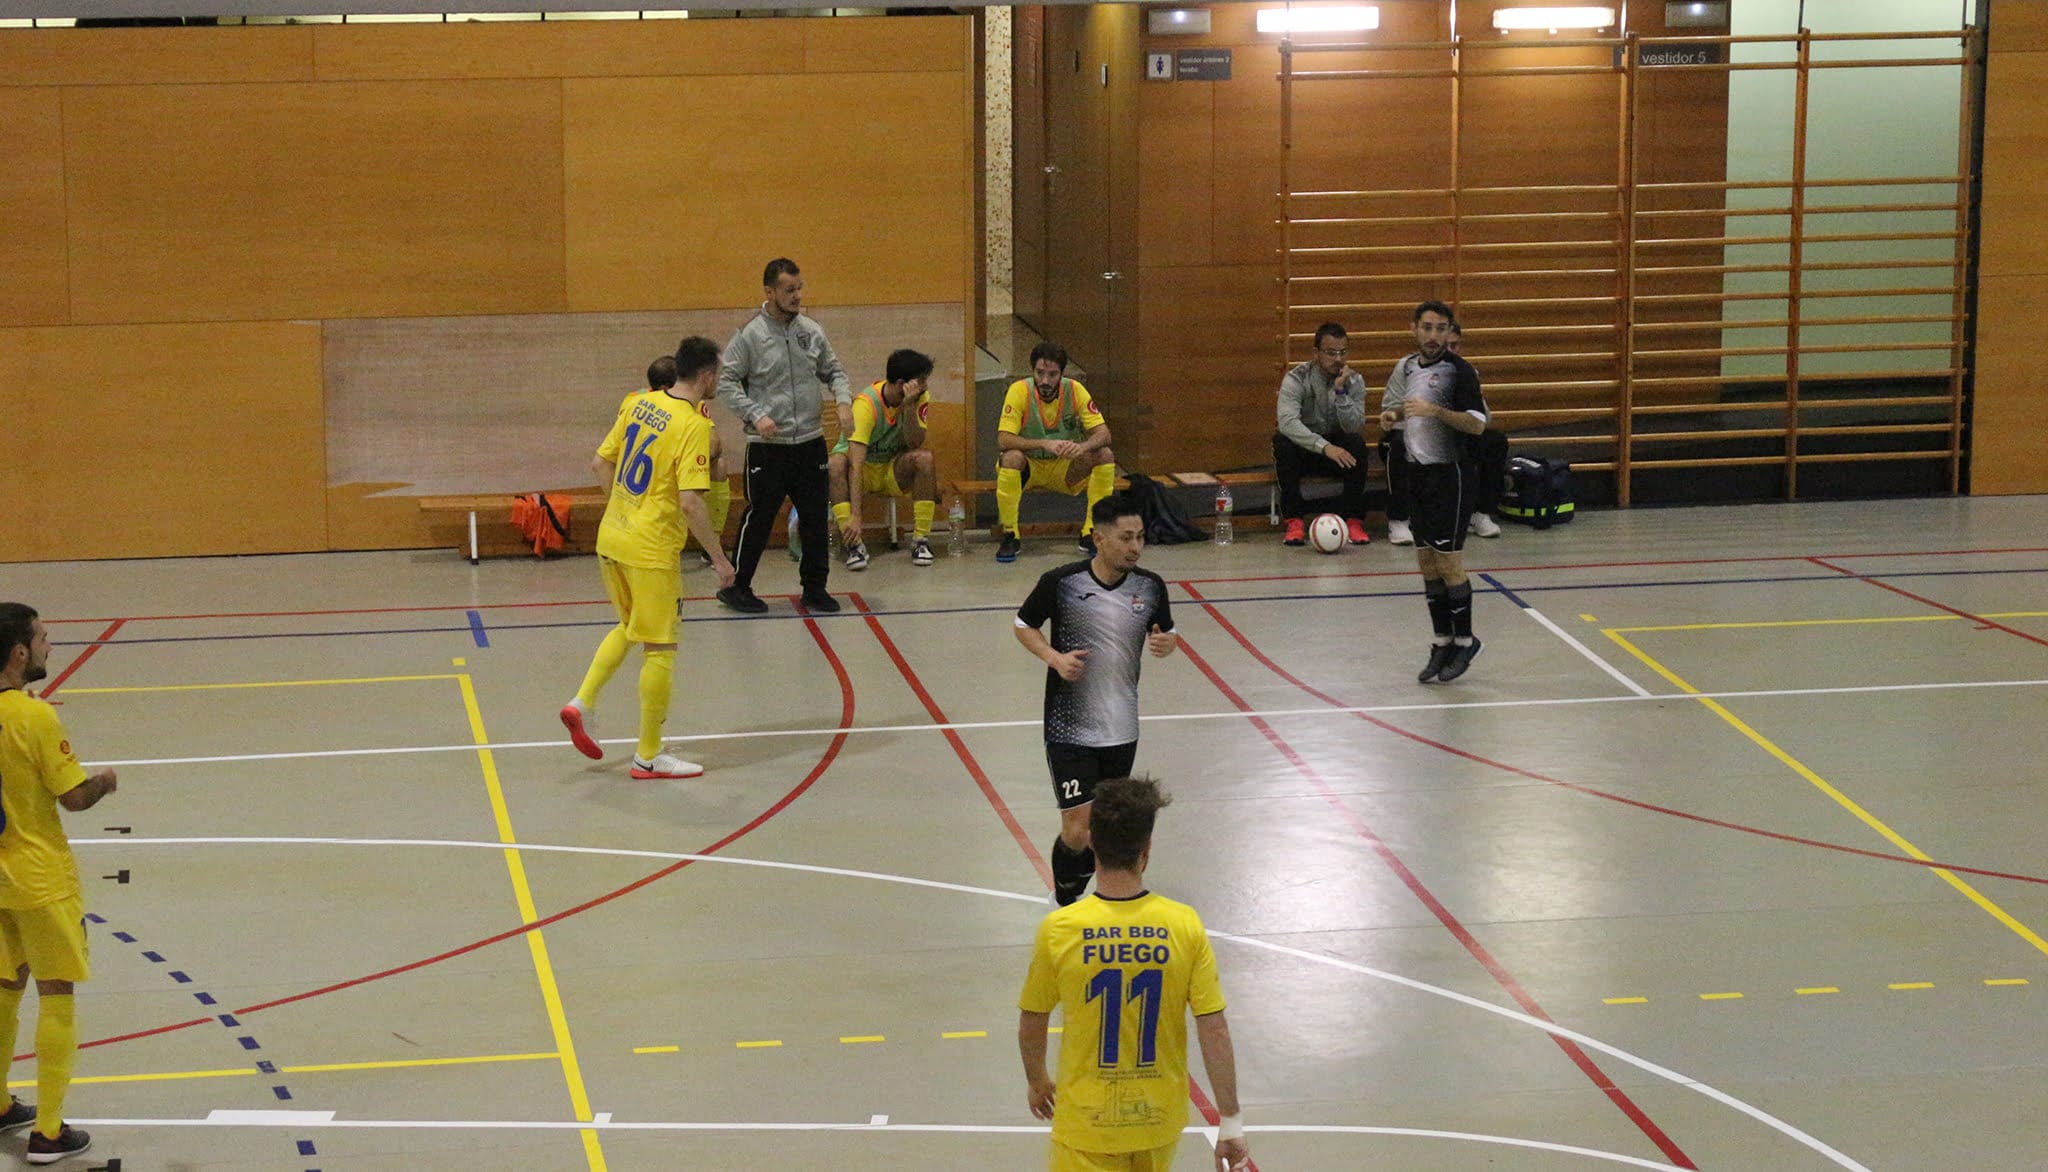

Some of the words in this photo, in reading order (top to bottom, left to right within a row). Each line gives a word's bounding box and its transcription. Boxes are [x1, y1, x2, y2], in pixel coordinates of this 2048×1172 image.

[1642, 52, 1694, 64] vestidor
[1698, 52, 1706, 63] 5
[631, 406, 667, 432] FUEGO
[638, 399, 657, 412] BAR
[655, 407, 672, 422] BBQ
[616, 422, 658, 496] 16
[1062, 779, 1082, 799] 22
[1083, 927, 1122, 940] BAR
[1129, 926, 1169, 940] BBQ
[1083, 944, 1170, 964] FUEGO
[1085, 969, 1163, 1068] 11
